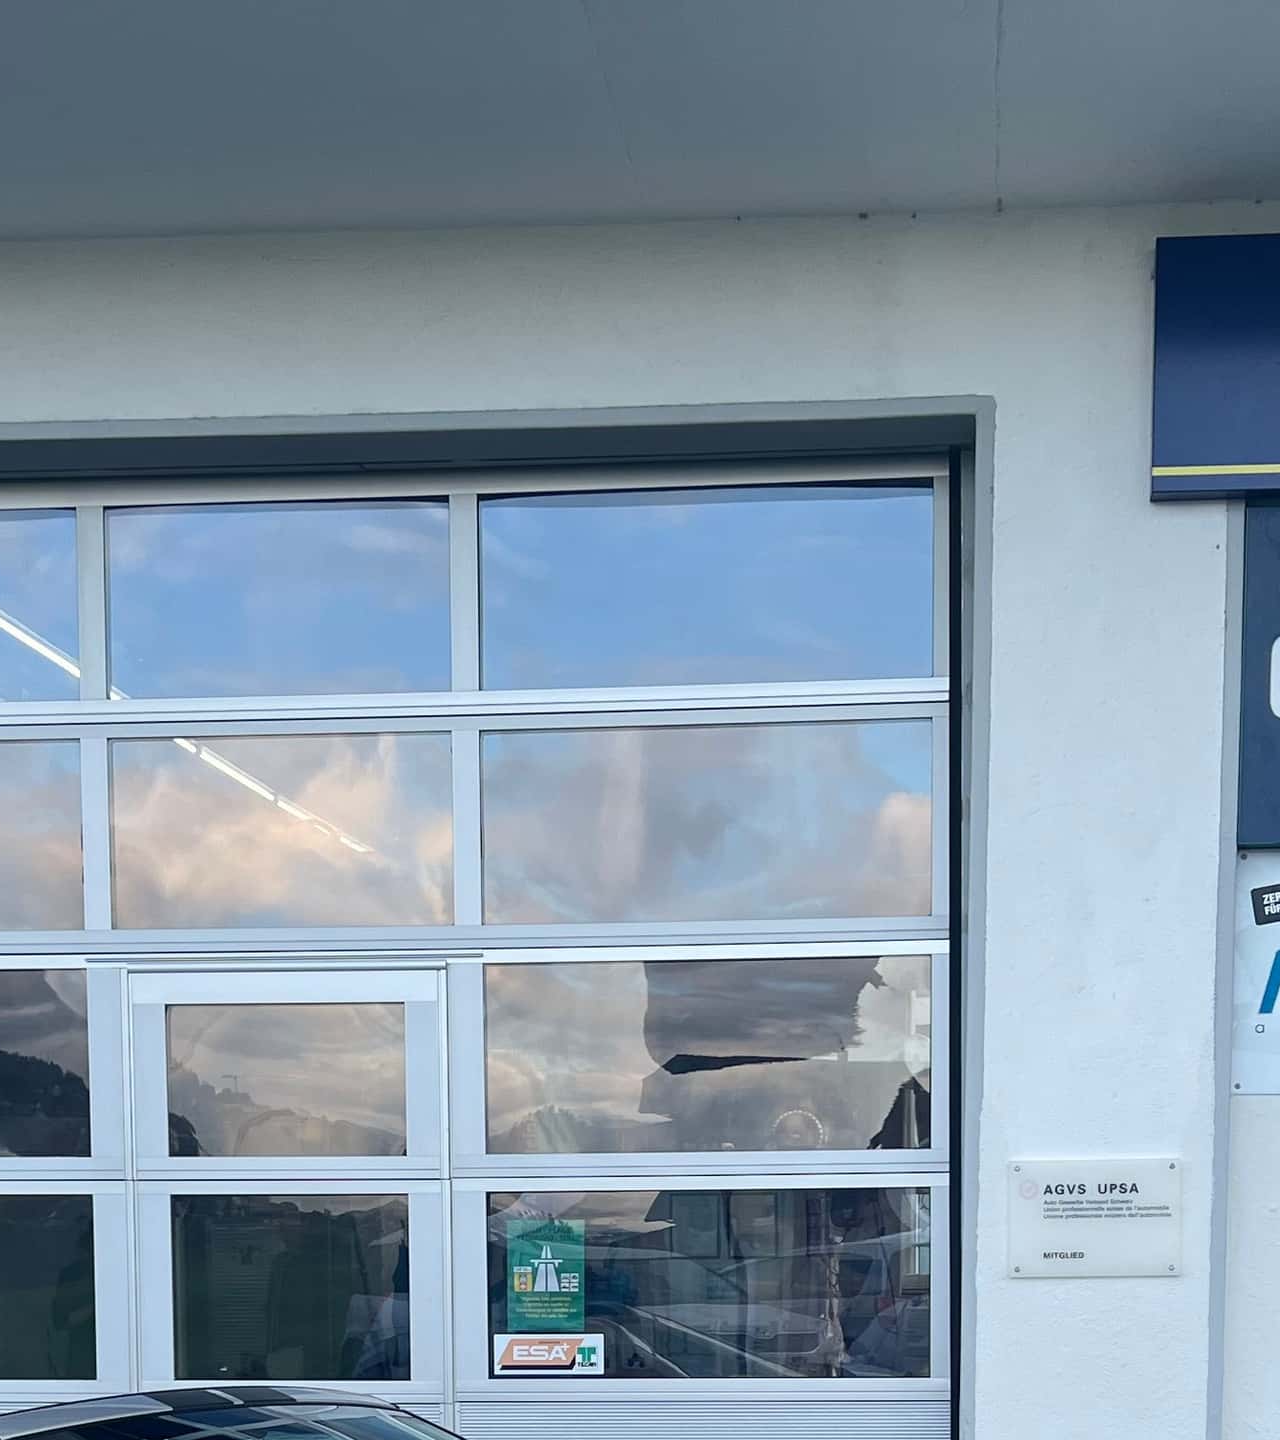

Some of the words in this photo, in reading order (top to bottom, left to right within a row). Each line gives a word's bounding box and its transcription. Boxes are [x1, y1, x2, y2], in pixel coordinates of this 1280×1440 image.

[1043, 1184, 1087, 1195] AGVS
[1097, 1183, 1140, 1194] UPSA
[1043, 1251, 1085, 1259] MITGLIED
